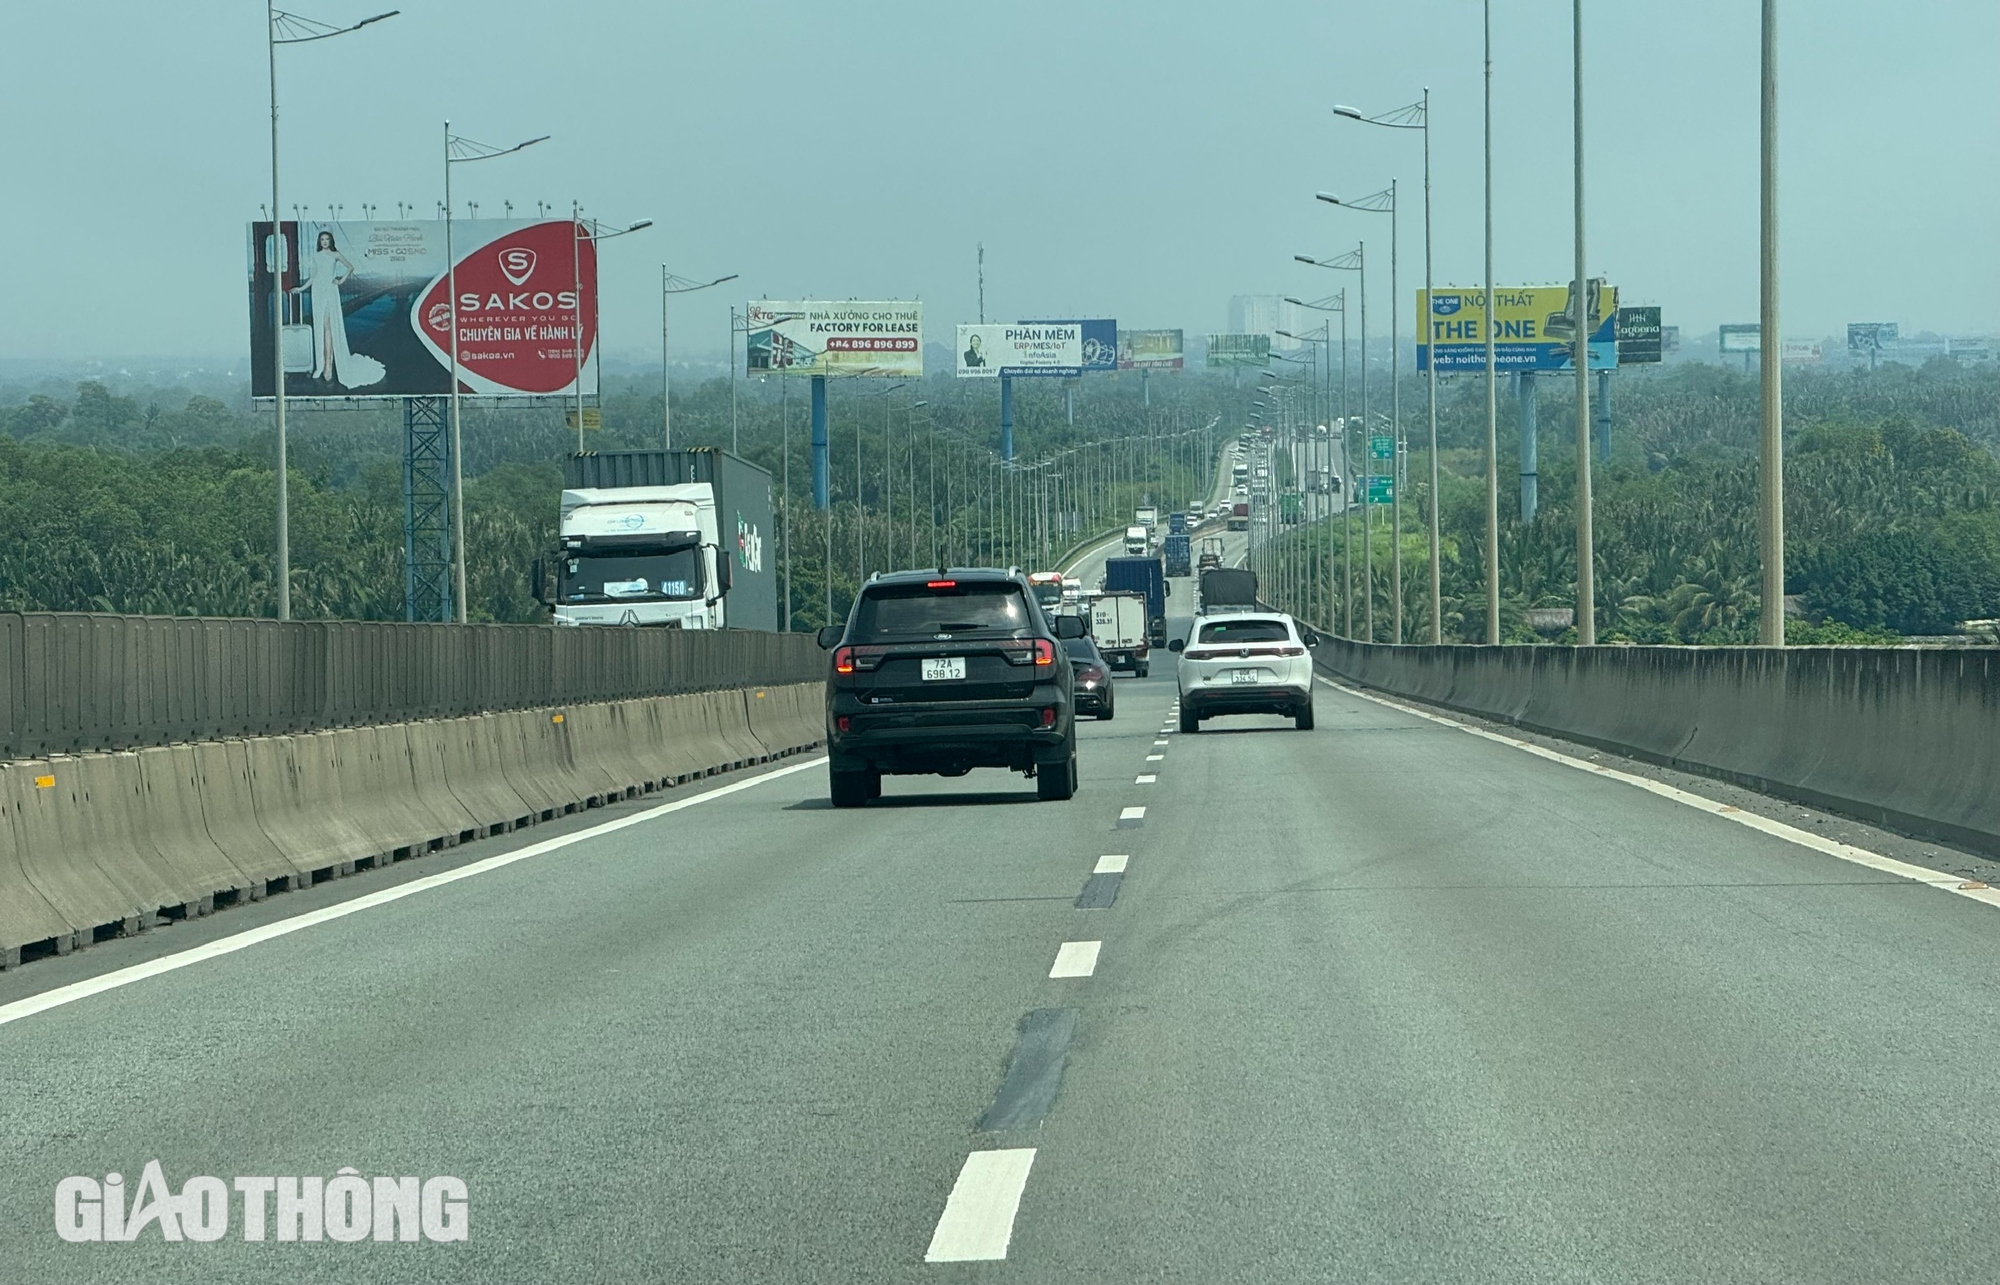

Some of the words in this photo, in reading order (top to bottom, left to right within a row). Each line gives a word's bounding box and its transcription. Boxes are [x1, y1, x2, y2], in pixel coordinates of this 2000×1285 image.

[508, 253, 529, 270] S
[460, 292, 577, 311] SAKOS
[1465, 291, 1486, 309] NỘ
[1495, 291, 1535, 306] THẤT
[754, 312, 773, 320] KTG
[810, 310, 830, 320] NHÀ
[833, 309, 869, 320] XƯỞNG
[872, 312, 892, 320] CHO
[895, 311, 918, 320] THUÊ
[810, 323, 860, 332] FACTORY
[863, 323, 884, 332] FOR
[886, 323, 918, 332] LEASE
[1433, 320, 1478, 339] THE
[460, 326, 501, 342] CHUYÊN
[504, 327, 521, 341] GIA
[524, 325, 537, 340] VỀ
[540, 324, 568, 340] HÀNH
[1005, 327, 1041, 340] PHẦN
[1045, 327, 1075, 340] MỀM
[830, 341, 849, 350] +84
[852, 341, 871, 349] 896
[874, 341, 893, 349] 896
[895, 341, 915, 349] 899
[1014, 342, 1066, 350] ERP/MES/IoT
[471, 351, 515, 360] sakos.vn
[935, 659, 952, 668] 72A
[927, 669, 961, 678] 698.12
